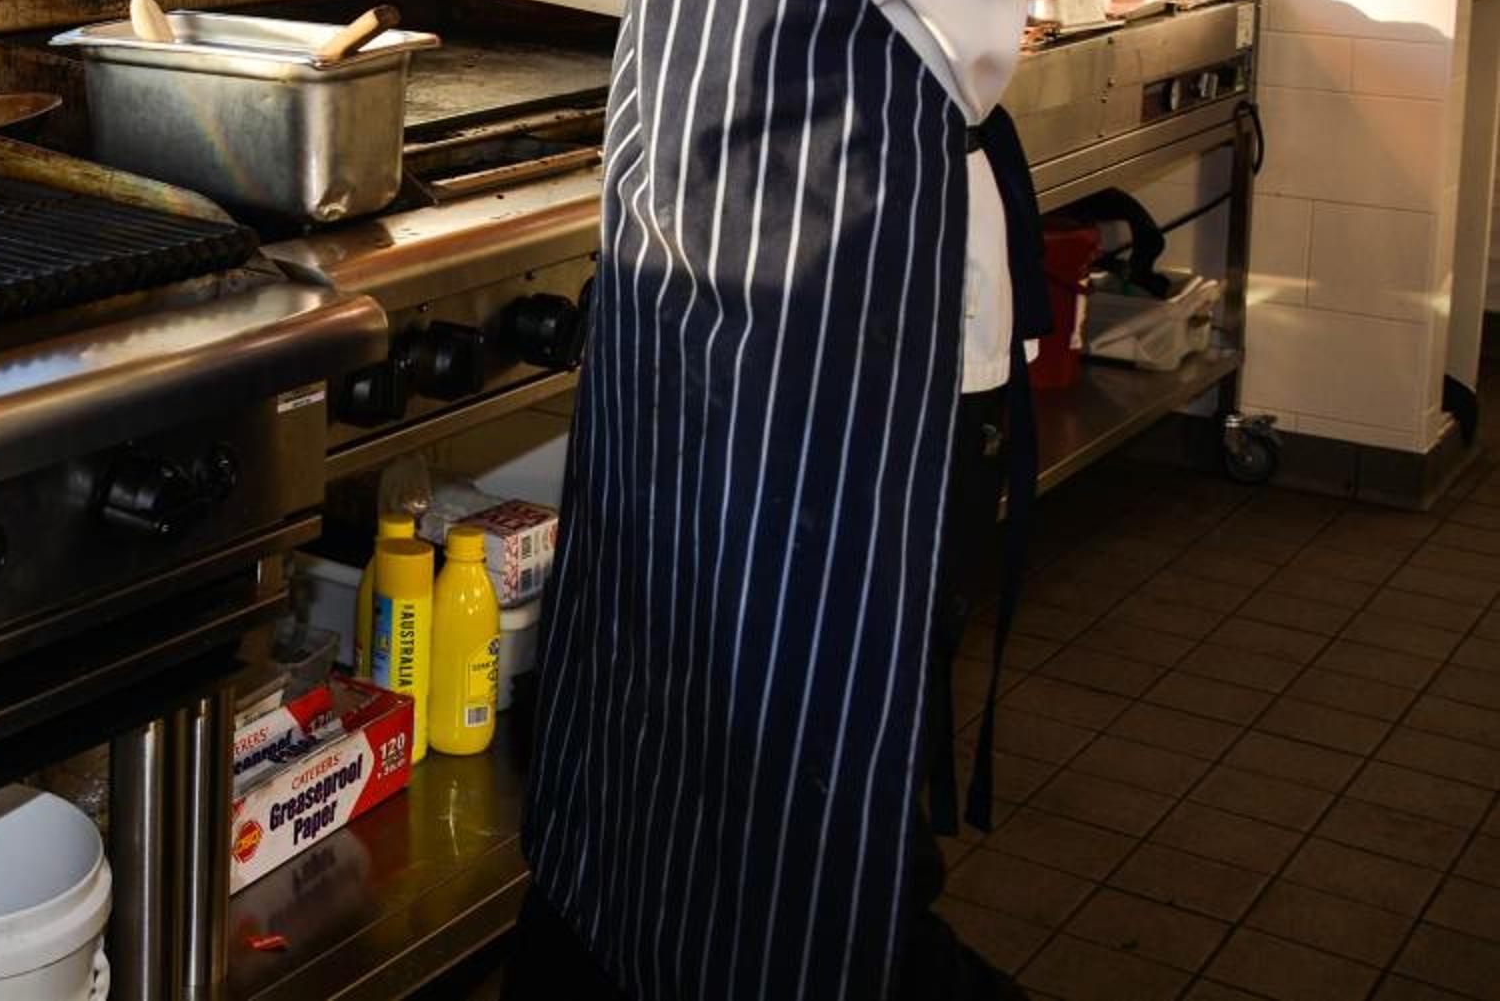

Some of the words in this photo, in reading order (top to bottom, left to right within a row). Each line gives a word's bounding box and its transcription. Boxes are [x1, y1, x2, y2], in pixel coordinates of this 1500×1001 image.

[398, 611, 415, 687] AUSTRALIA
[269, 754, 363, 831] Greaseproof
[293, 801, 338, 845] Paper
